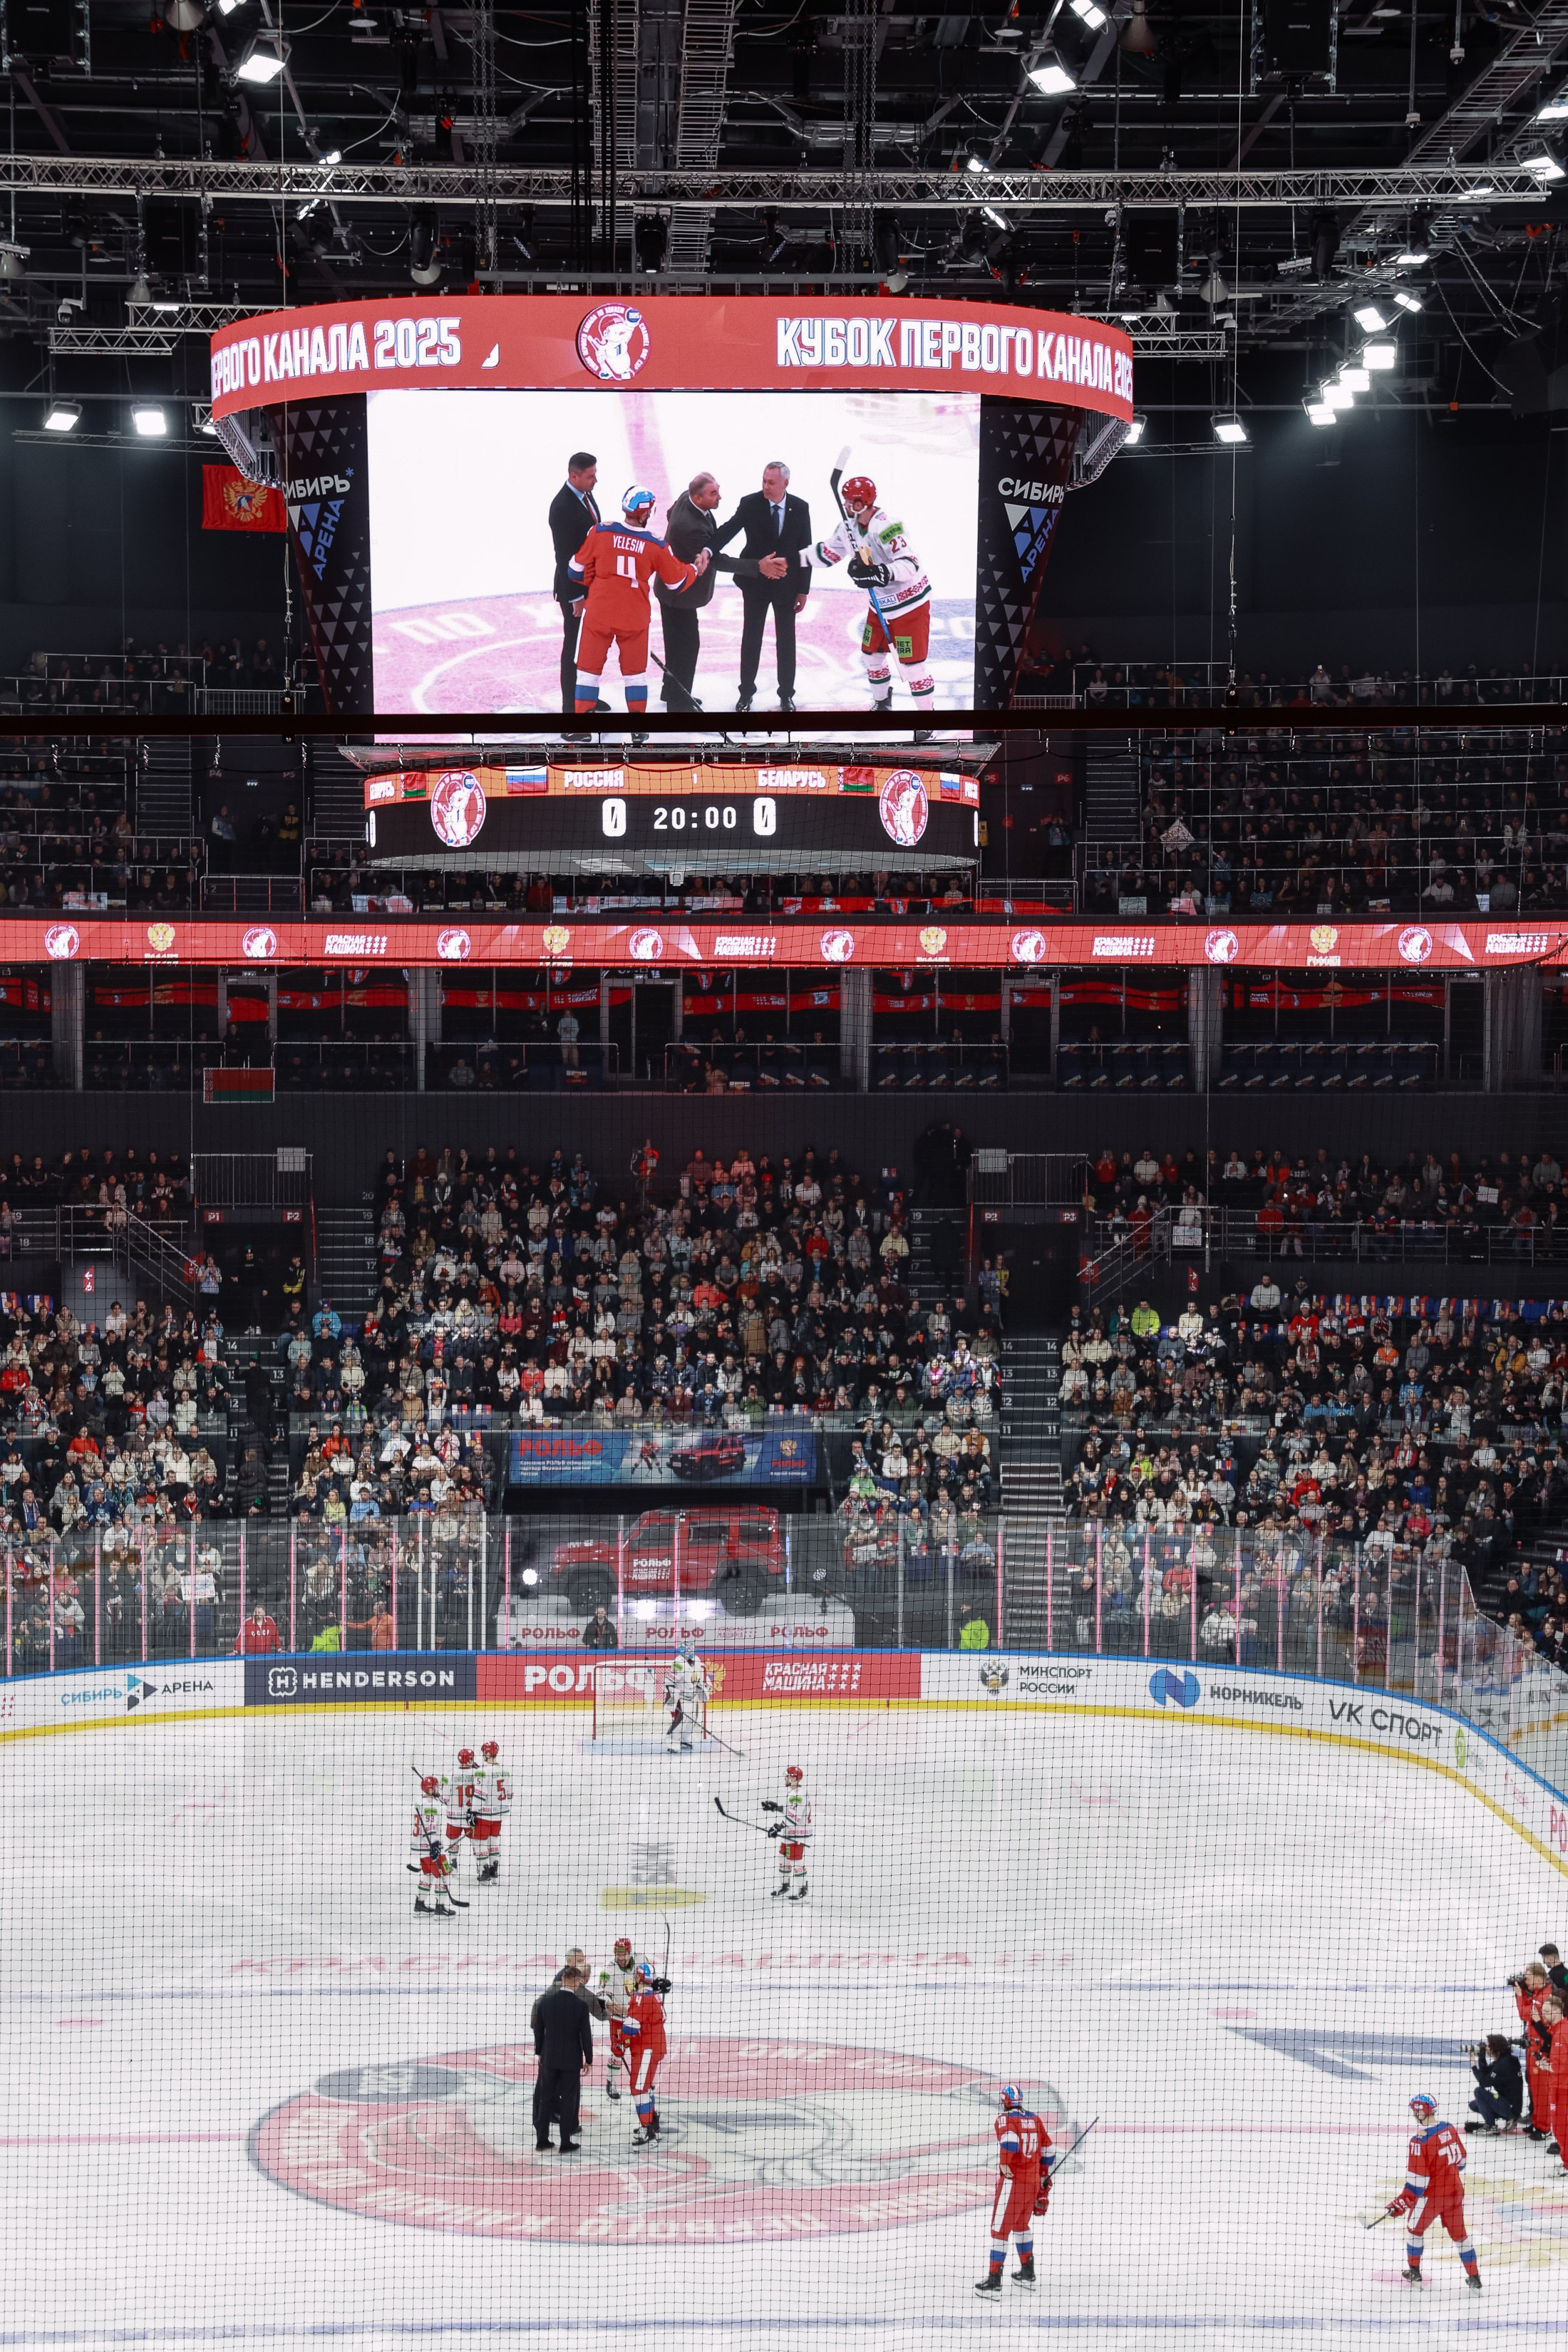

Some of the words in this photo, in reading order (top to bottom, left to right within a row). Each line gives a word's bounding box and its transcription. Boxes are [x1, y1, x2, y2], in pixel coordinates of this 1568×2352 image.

[264, 322, 371, 383] КАНАЛА
[374, 317, 462, 369] 2025
[776, 318, 896, 367] КУБОК
[900, 319, 1033, 376] ПЕРВОГО
[1038, 330, 1113, 393] КАНАЛА
[282, 474, 351, 499] СИБИРЬ
[998, 477, 1064, 503] СИБИРЬ
[312, 499, 345, 581] АРЕНА
[613, 535, 645, 554] YELESIN
[889, 536, 907, 553] 23
[1021, 510, 1059, 584] АРЕНА
[617, 556, 639, 588] 4
[879, 597, 896, 605] SKALI
[564, 770, 624, 788] РОССИЯ
[692, 773, 698, 785] 1
[758, 770, 826, 788] БЕЛАРУСЬ
[602, 798, 626, 837] 0
[654, 806, 736, 830] 20:00
[753, 797, 776, 835] 0
[326, 935, 366, 944] КРАСНАЯ
[324, 944, 365, 954] МАШИНА
[227, 1341, 237, 1350] 14
[1002, 1341, 1012, 1350] 14
[1046, 1341, 1057, 1350] 14
[273, 1370, 284, 1379] 13
[1003, 1369, 1013, 1378] 13
[1046, 1369, 1057, 1378] 13
[229, 1399, 239, 1408] 12
[1002, 1397, 1012, 1405] 12
[1047, 1397, 1057, 1406] 12
[229, 1428, 238, 1437] 11
[1003, 1425, 1011, 1434] 11
[1048, 1425, 1056, 1434] 11
[520, 1440, 602, 1456] РОЛЬФ
[634, 1559, 671, 1567] РОЛЬФ
[522, 1627, 580, 1639] РОЛЬФ
[646, 1627, 704, 1639] РОЛЬФ
[770, 1626, 829, 1638] РОЛЬФ
[765, 1663, 827, 1675] КРАСНАЯ
[1020, 1666, 1093, 1679] МИНСПОРТ
[303, 1670, 455, 1689] HENDERSON
[762, 1676, 825, 1691] МАШИНА
[162, 1680, 214, 1693] АРЕНА
[1020, 1682, 1075, 1694] РОССИИ
[61, 1688, 123, 1706] СИБИРЬ
[1210, 1686, 1303, 1710] НОРНИКЕЛЬ
[1329, 1699, 1364, 1725] VK
[1372, 1708, 1443, 1747] СПОРТ
[497, 1779, 506, 1800] 5
[227, 1954, 606, 1974] КРАСНА
[635, 1996, 641, 2006] 4
[1410, 2142, 1421, 2156] 70
